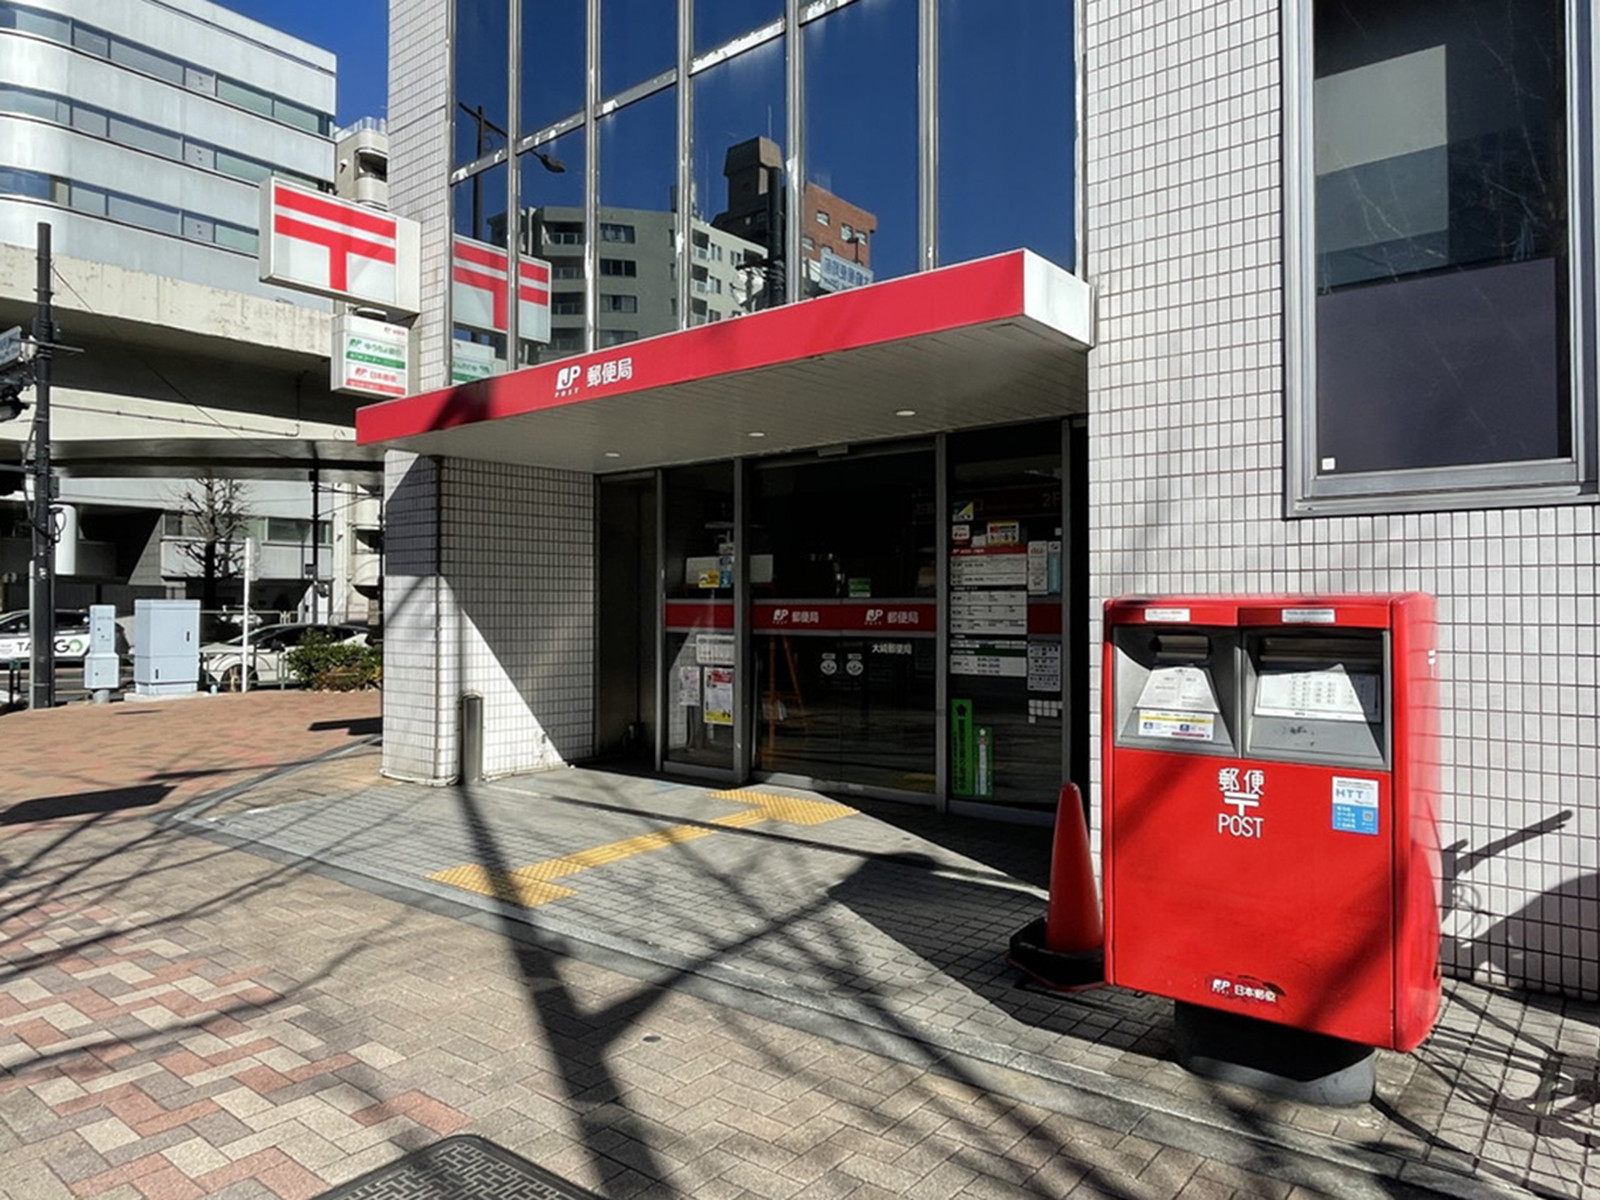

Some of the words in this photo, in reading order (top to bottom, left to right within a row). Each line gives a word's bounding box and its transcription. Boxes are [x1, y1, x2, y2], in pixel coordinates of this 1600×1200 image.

[587, 357, 633, 388] 郵便局
[791, 610, 820, 624] 郵便局
[886, 610, 920, 625] 郵便局
[1218, 767, 1265, 796] 郵便
[1218, 813, 1265, 839] POST
